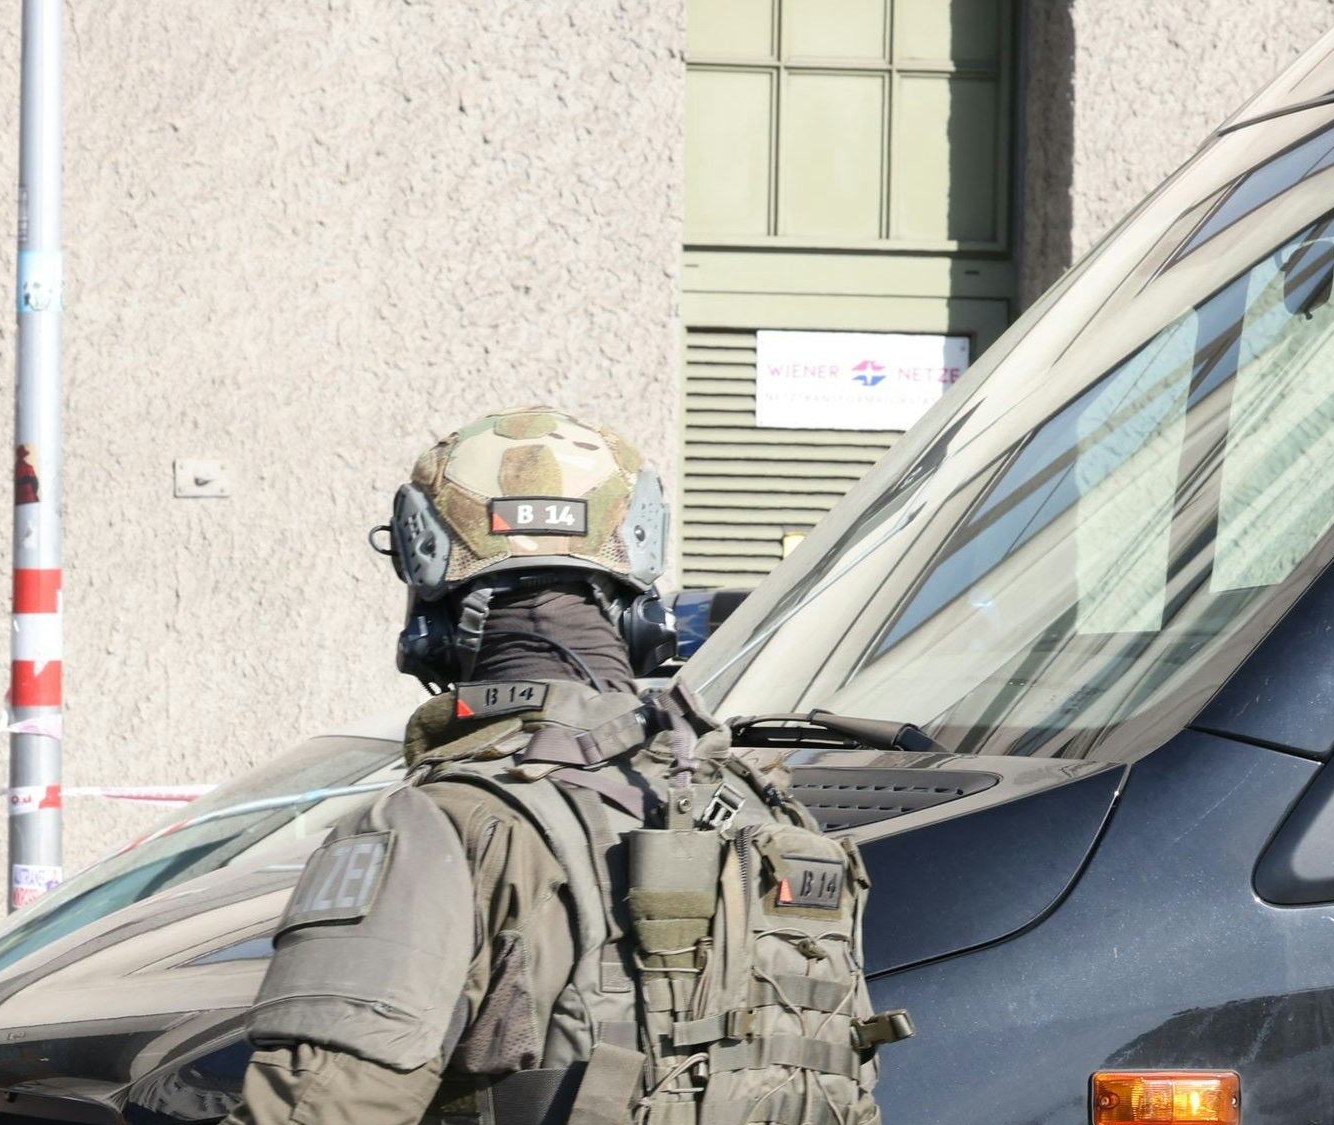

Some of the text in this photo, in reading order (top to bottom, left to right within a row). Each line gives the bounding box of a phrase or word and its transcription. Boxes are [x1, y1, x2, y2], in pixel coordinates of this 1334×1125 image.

[767, 364, 961, 385] WIENER NETZE
[516, 504, 576, 526] B 14
[485, 684, 534, 707] B 14
[800, 869, 838, 899] B 14
